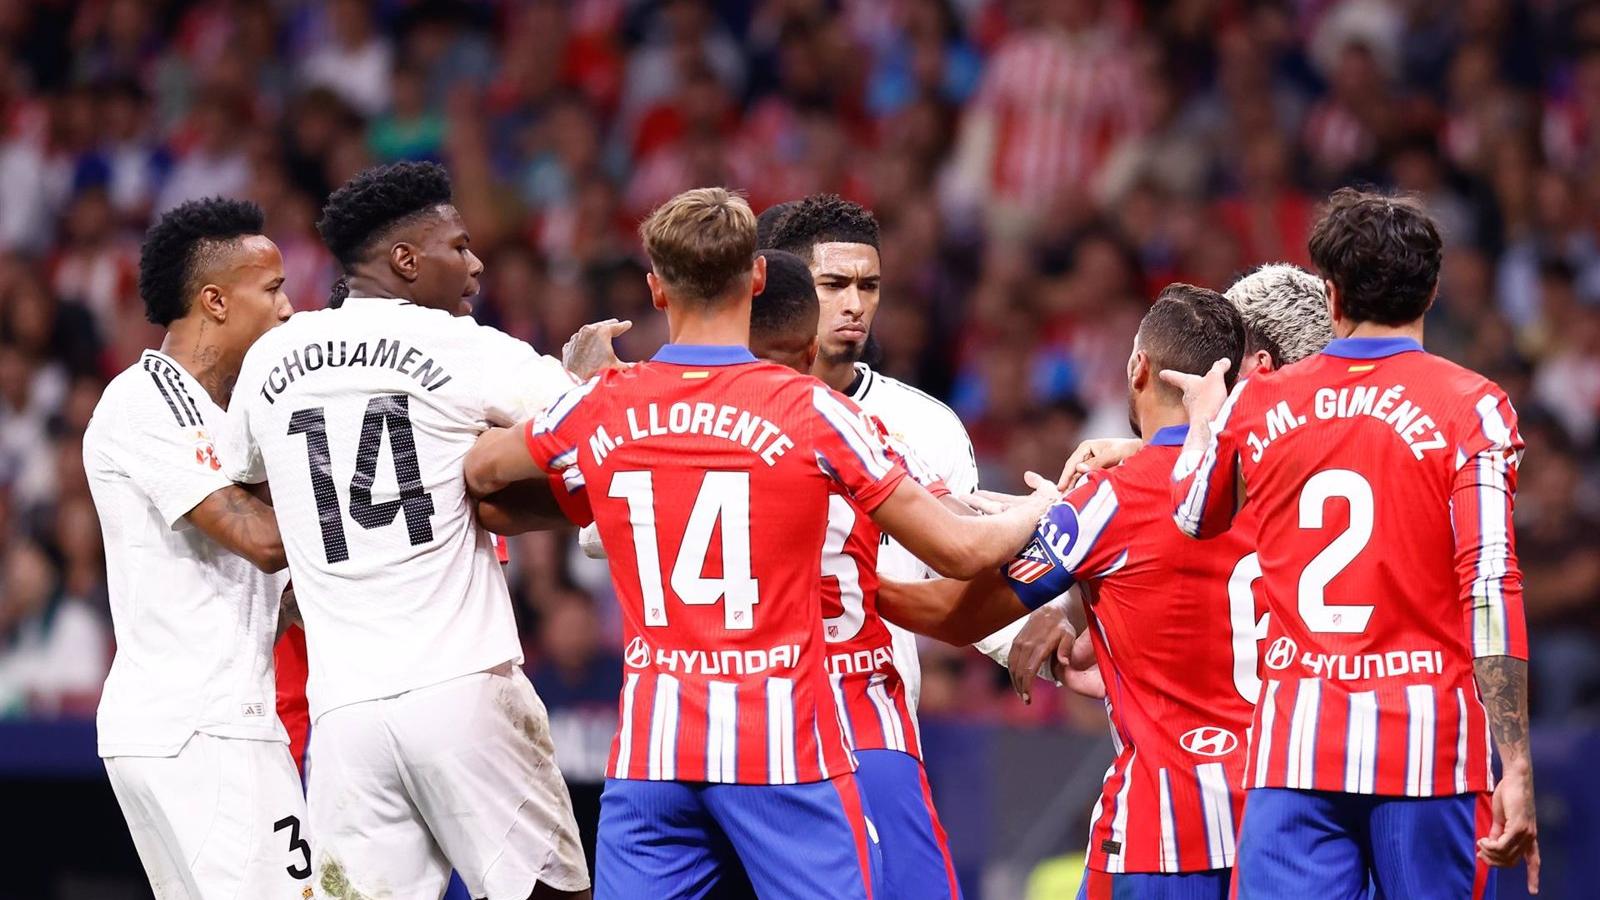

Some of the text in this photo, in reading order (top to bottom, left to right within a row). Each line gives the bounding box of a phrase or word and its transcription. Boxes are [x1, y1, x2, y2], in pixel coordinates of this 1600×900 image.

[261, 338, 452, 405] TCHOUAMENI
[588, 403, 794, 467] M. LLORENTE
[1247, 385, 1448, 462] J.M. GIMÉNEZ
[287, 394, 435, 564] 14
[607, 470, 759, 630] 14
[1298, 468, 1375, 634] 2
[656, 644, 801, 675] HYUNDAI
[1301, 650, 1443, 680] HYUNDAI
[277, 815, 312, 879] 3
